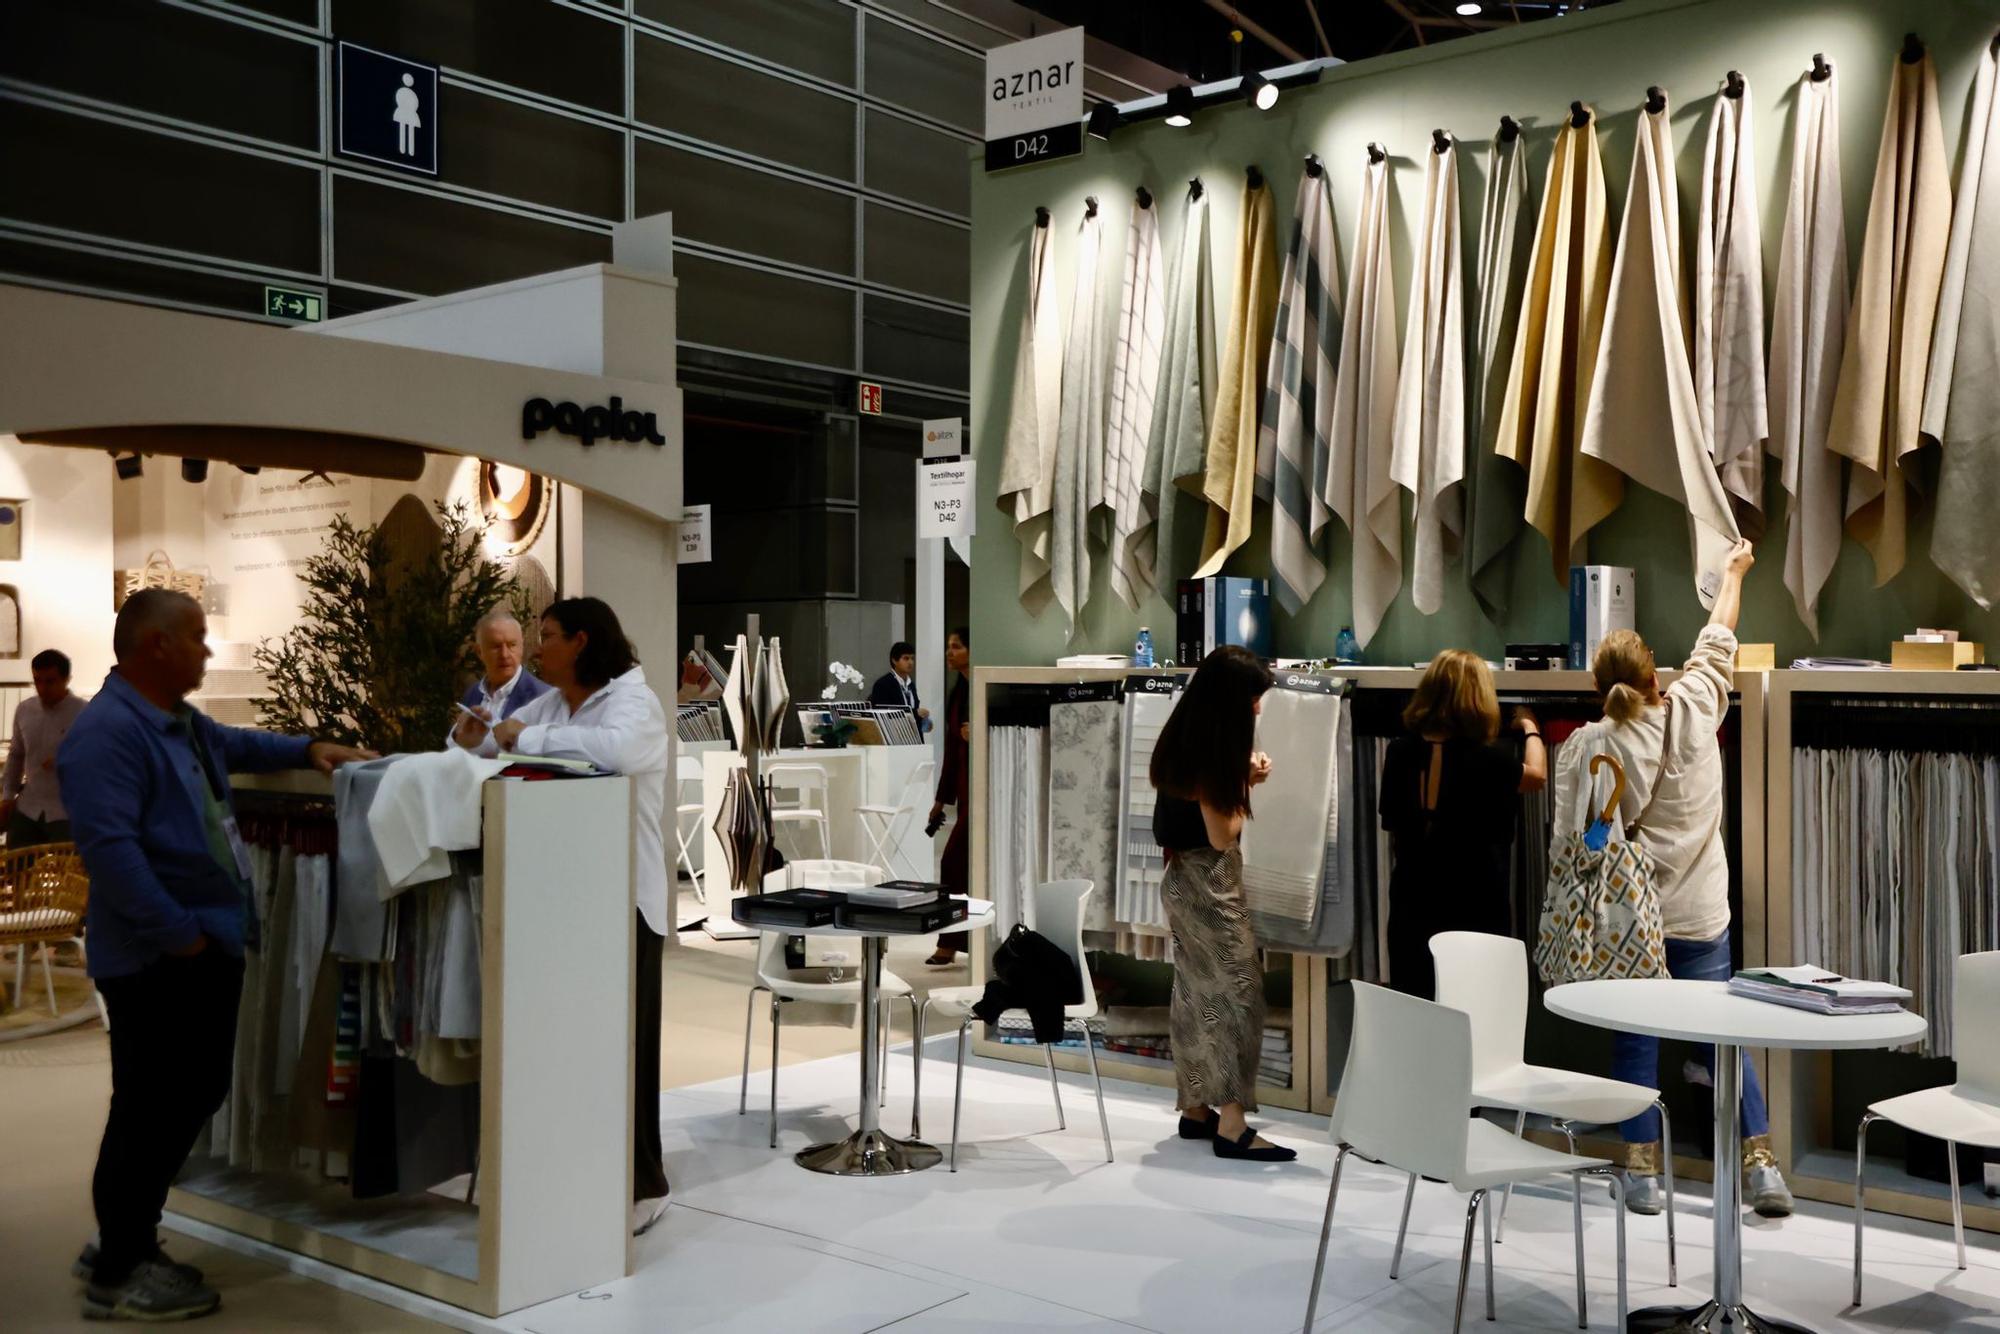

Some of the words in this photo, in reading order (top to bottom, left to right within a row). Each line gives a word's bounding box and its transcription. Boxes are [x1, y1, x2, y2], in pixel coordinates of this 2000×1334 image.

[993, 61, 1074, 101] aznar
[1015, 135, 1048, 159] D42
[930, 471, 965, 480] Textilhogar
[934, 499, 961, 511] N3-P3
[938, 512, 956, 522] D42
